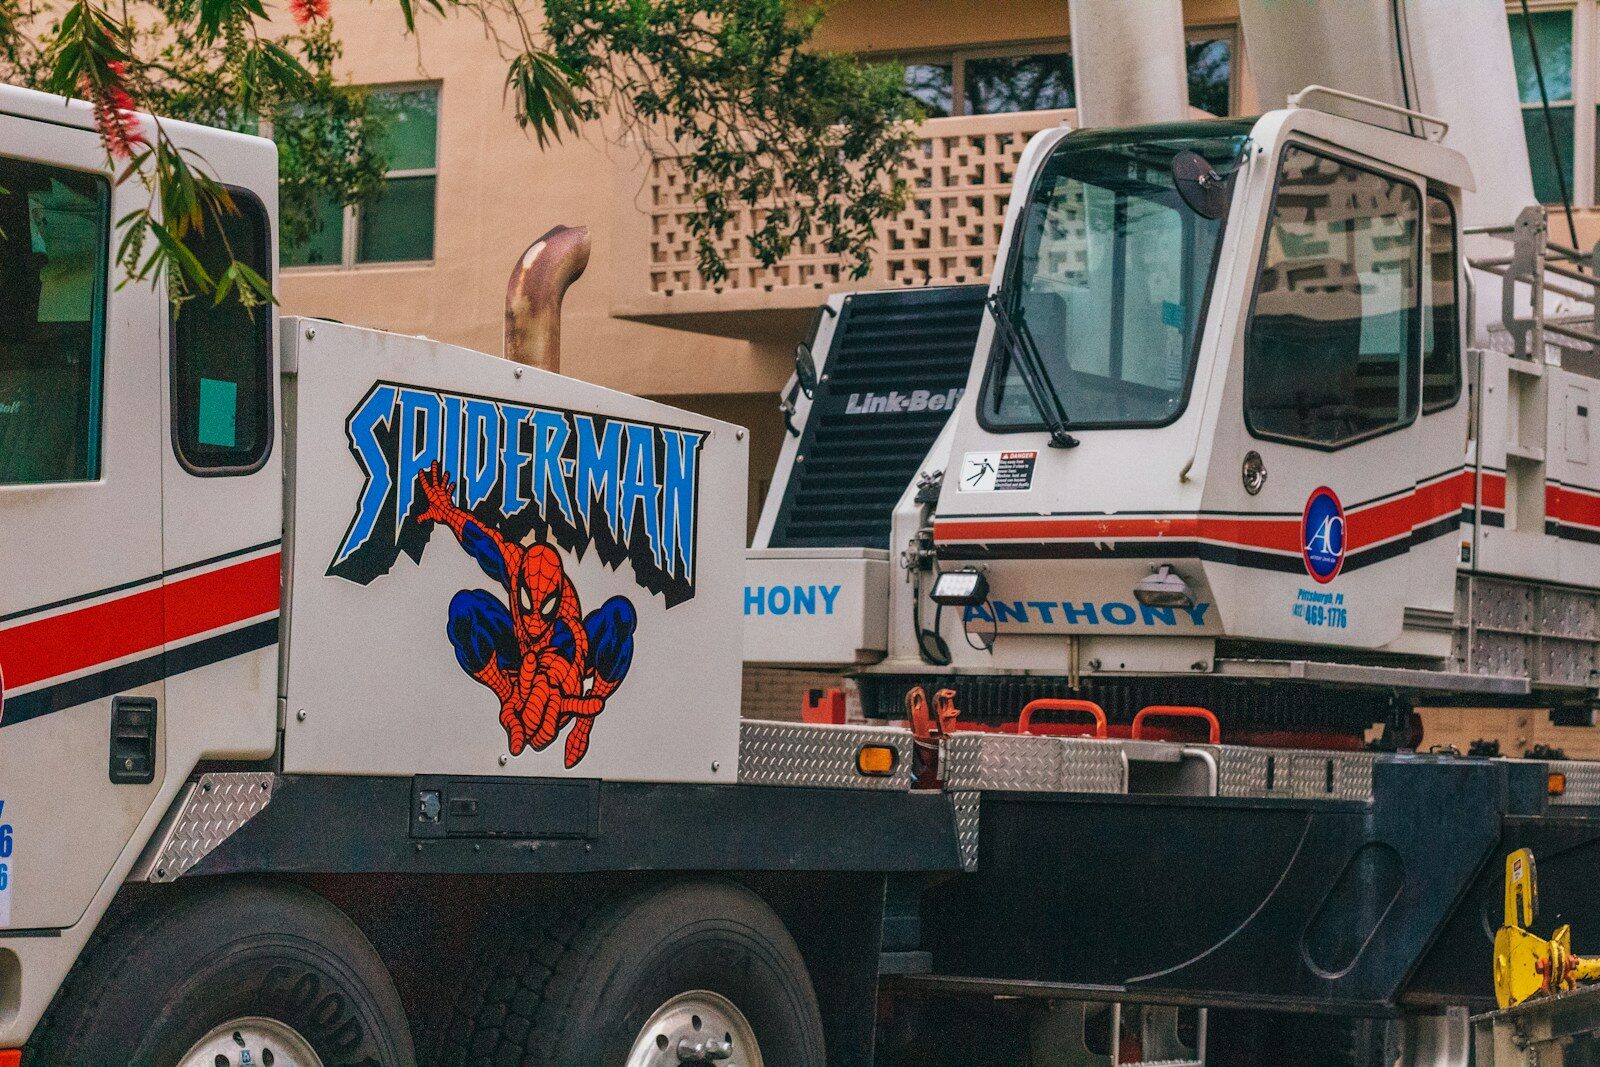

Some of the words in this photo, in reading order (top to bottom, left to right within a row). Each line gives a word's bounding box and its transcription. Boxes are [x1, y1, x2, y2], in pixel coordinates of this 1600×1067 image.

[332, 383, 707, 592] SPIDER-MAN
[1304, 514, 1344, 557] AC
[963, 600, 1210, 626] ANTHONY
[1305, 604, 1347, 629] 469-1776
